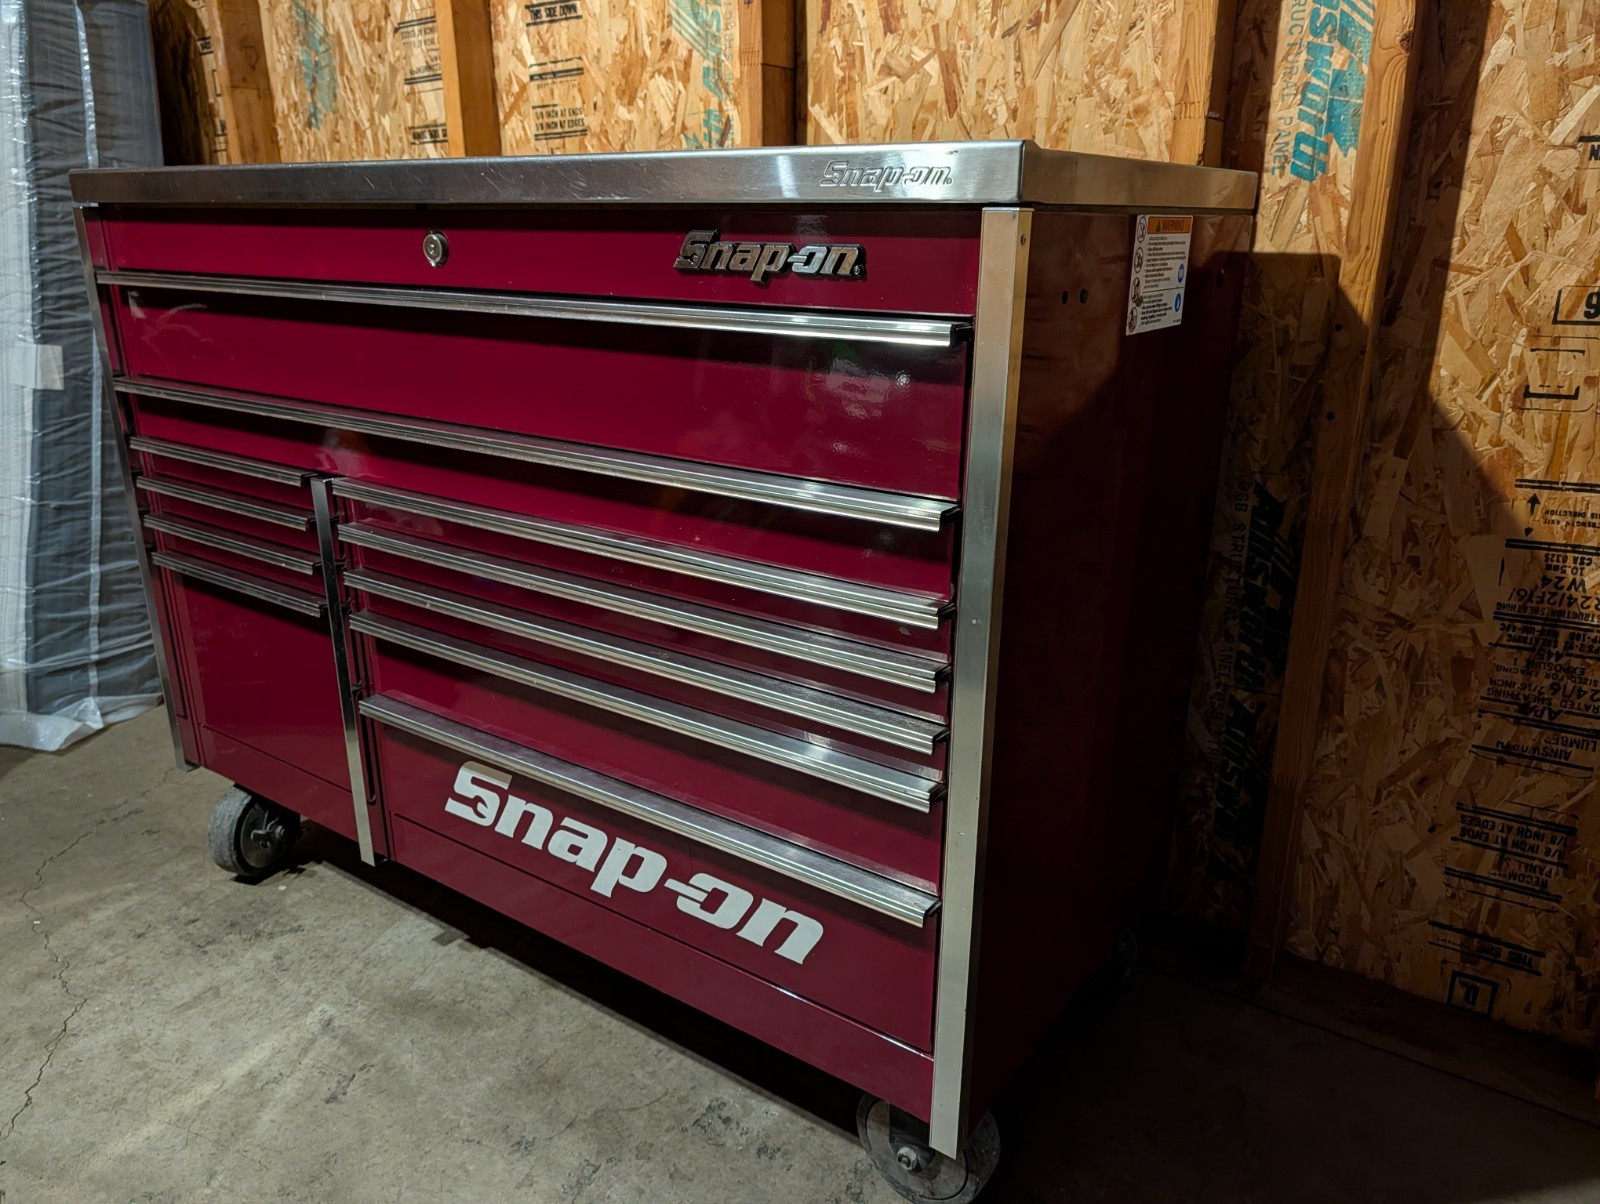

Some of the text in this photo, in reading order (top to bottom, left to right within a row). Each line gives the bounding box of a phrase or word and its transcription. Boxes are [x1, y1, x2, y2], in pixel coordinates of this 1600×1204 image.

[559, 3, 578, 17] DOWN
[568, 118, 585, 128] EDGES
[1272, 116, 1293, 176] PANEL
[820, 160, 951, 192] Snap-on
[673, 229, 864, 284] Snap-on
[1540, 575, 1586, 593] W24
[1525, 659, 1586, 676] EXPOSURE
[1489, 677, 1516, 691] INCH
[1544, 672, 1565, 682] FOR
[1487, 689, 1553, 706] SHEATHING
[1460, 814, 1495, 830] EDGES
[1499, 823, 1514, 835] AT
[1459, 826, 1489, 843] ENDS
[1493, 836, 1508, 848] AT
[1516, 827, 1545, 843] INCH
[1511, 839, 1539, 854] INCH
[444, 760, 824, 965] Snap-on
